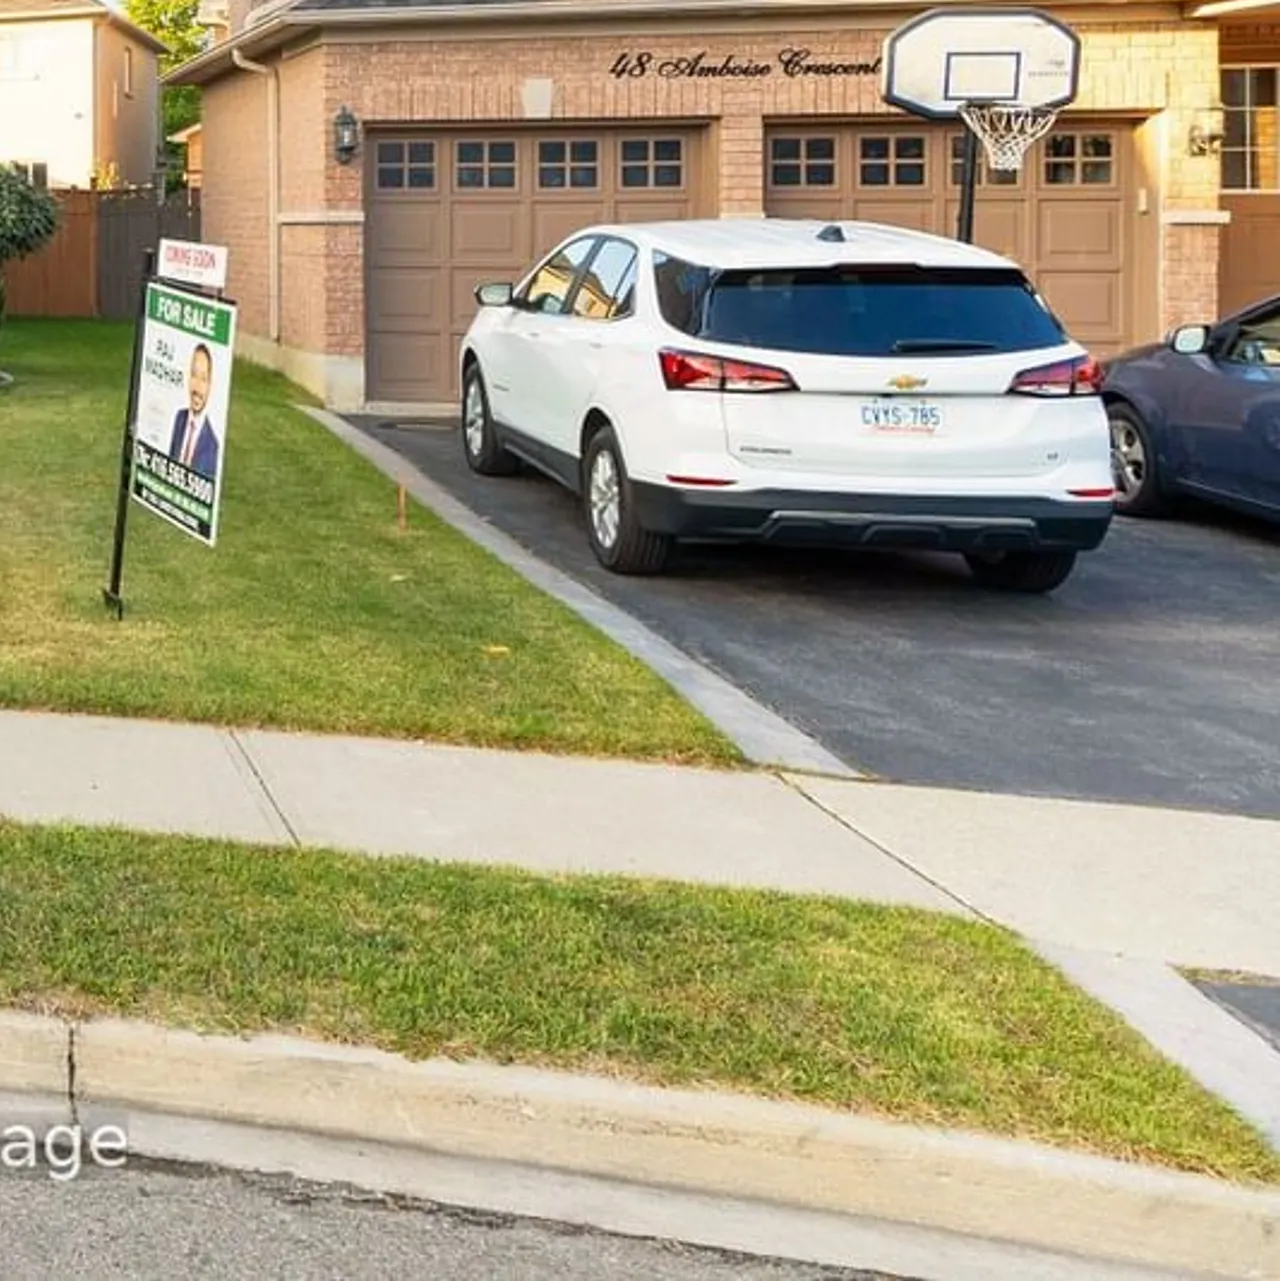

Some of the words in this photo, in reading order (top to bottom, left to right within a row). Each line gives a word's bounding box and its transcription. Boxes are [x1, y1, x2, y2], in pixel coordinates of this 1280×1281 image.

[610, 52, 652, 80] 48
[658, 51, 773, 79] Amboise
[156, 297, 181, 324] FOR
[183, 304, 216, 336] SALE
